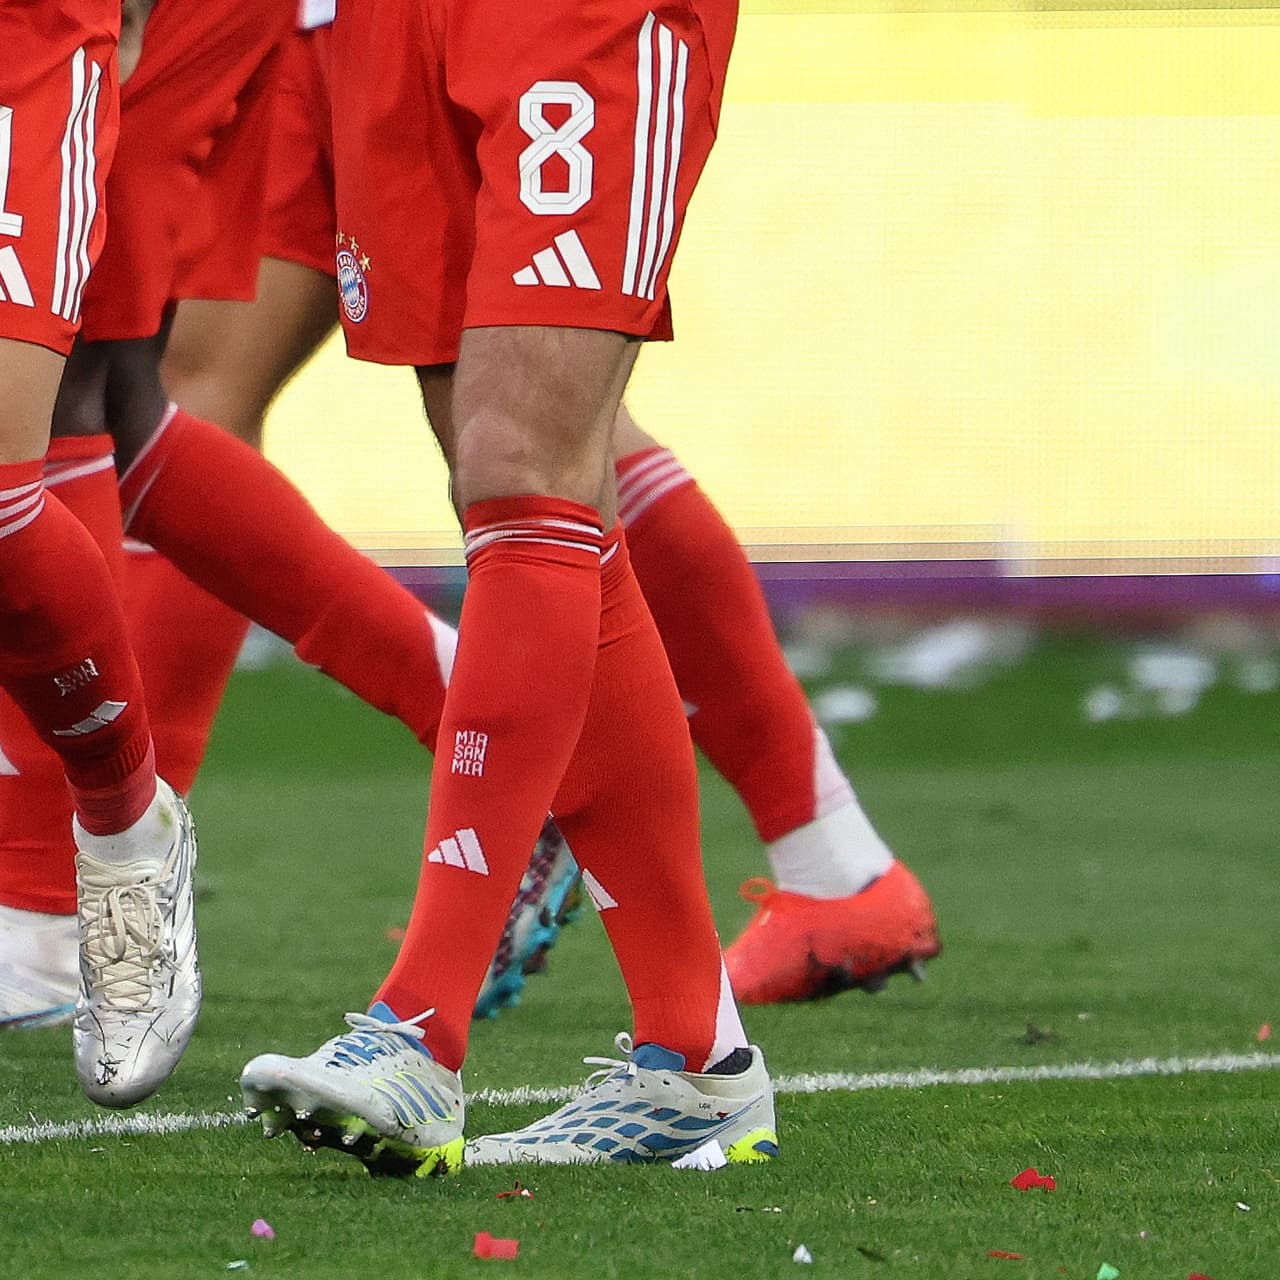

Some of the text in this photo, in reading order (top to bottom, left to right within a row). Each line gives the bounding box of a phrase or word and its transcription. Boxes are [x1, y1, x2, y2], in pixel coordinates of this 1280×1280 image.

[518, 80, 594, 215] 8
[455, 730, 488, 747] MIA
[454, 744, 485, 762] SAN
[451, 759, 483, 777] MIA
